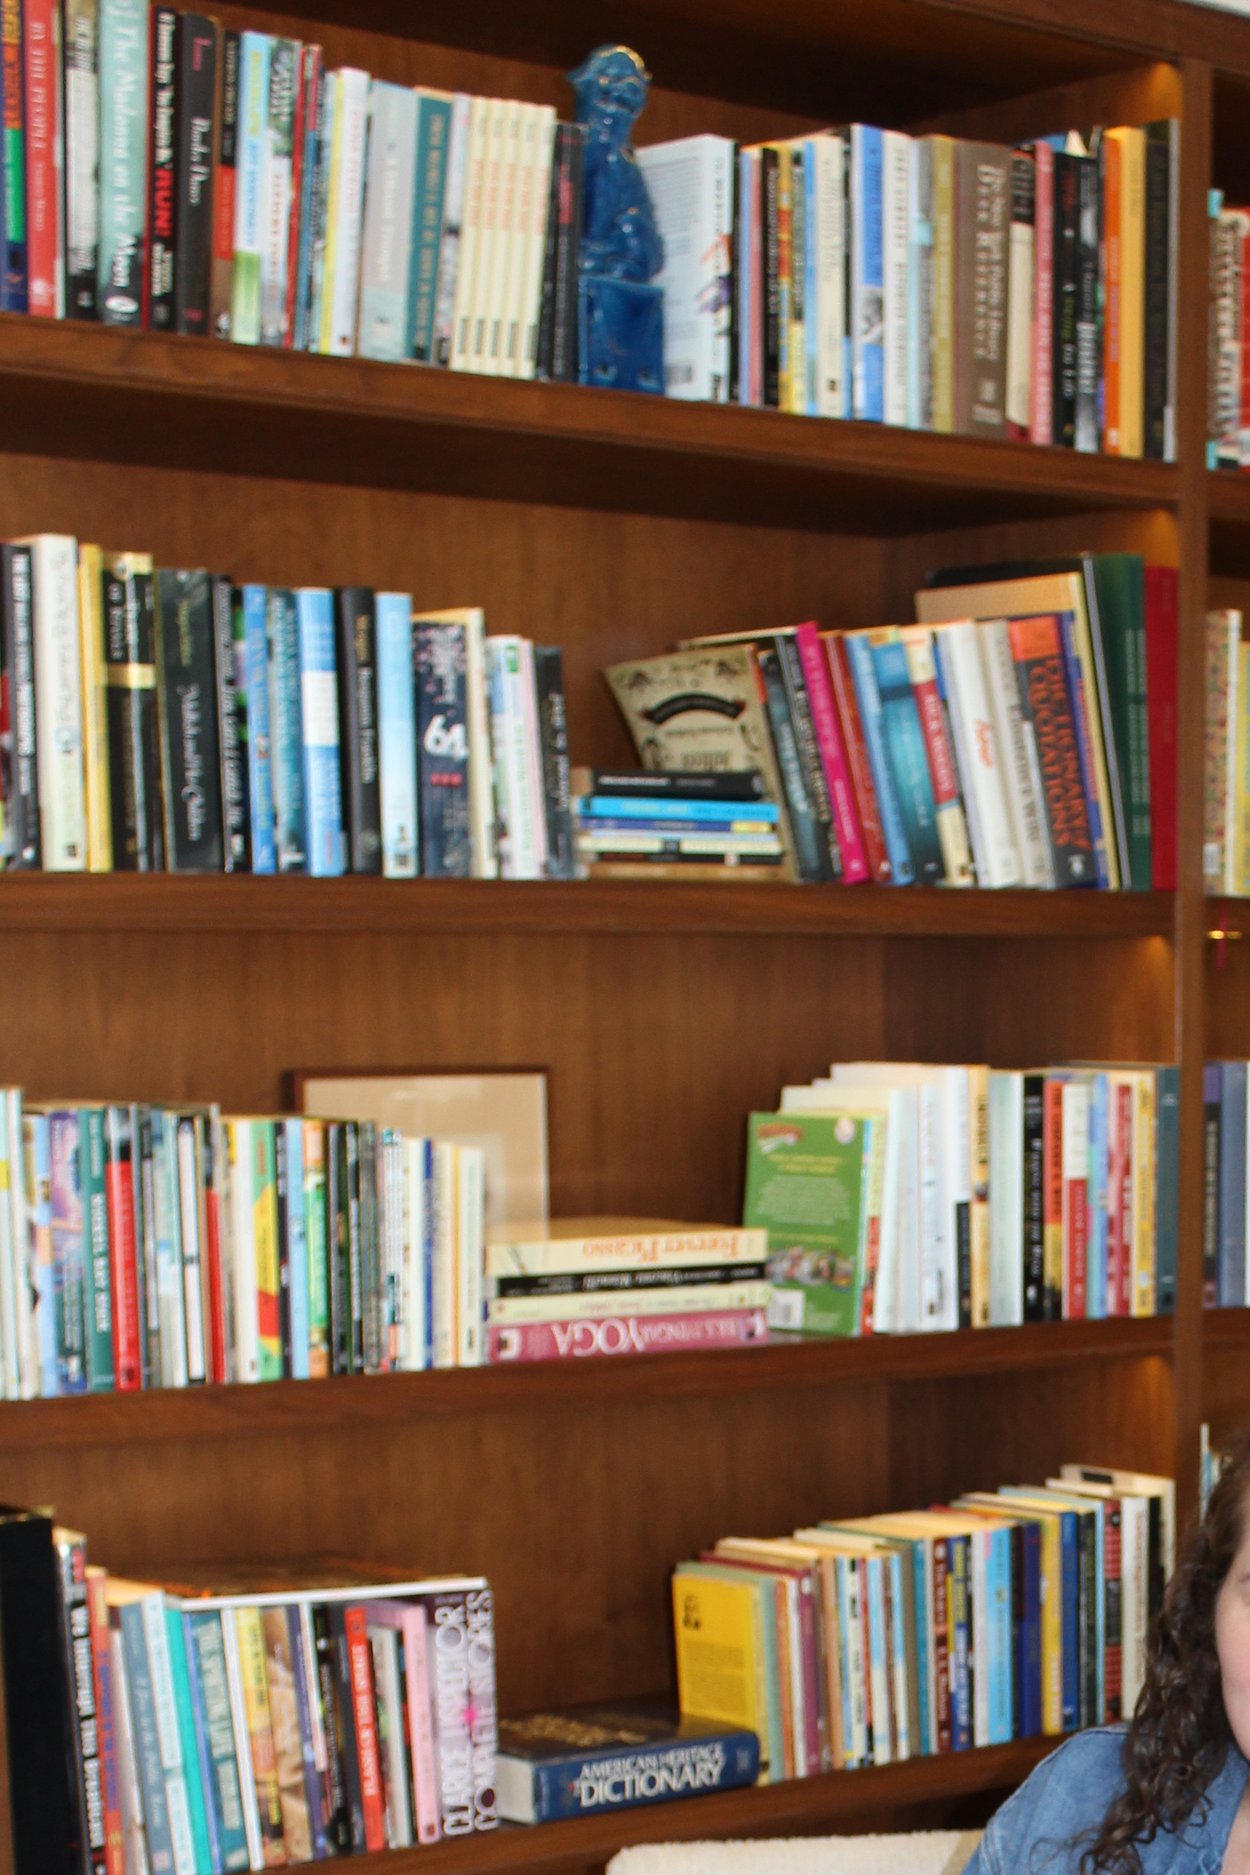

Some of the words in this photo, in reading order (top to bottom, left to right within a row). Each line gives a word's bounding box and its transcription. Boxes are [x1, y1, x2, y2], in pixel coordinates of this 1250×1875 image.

[113, 25, 138, 62] The
[30, 87, 46, 150] PEOPLE
[112, 71, 138, 159] Madonna
[112, 164, 129, 189] on
[153, 168, 172, 237] RUN!
[112, 194, 138, 227] the
[111, 233, 138, 288] Moon
[356, 668, 374, 728] Benjamin
[359, 729, 377, 784] Franklin
[1028, 666, 1071, 848] QUOTATIONS
[1043, 659, 1090, 838] DICTIONARY
[581, 1239, 658, 1264] Picasso
[551, 1317, 645, 1357] YOGA
[72, 1605, 90, 1637] We
[466, 1592, 495, 1698] STORIES
[74, 1637, 96, 1715] Interrupt
[434, 1606, 472, 1737] LISPECTOR
[80, 1716, 99, 1757] This
[580, 1752, 658, 1781] AMERICAN
[657, 1741, 723, 1769] HERITAGE
[441, 1743, 475, 1836] CLARICE
[472, 1704, 499, 1832] COMPLETE
[580, 1760, 727, 1808] DICTIONARY
[84, 1758, 106, 1848] Broadcast
